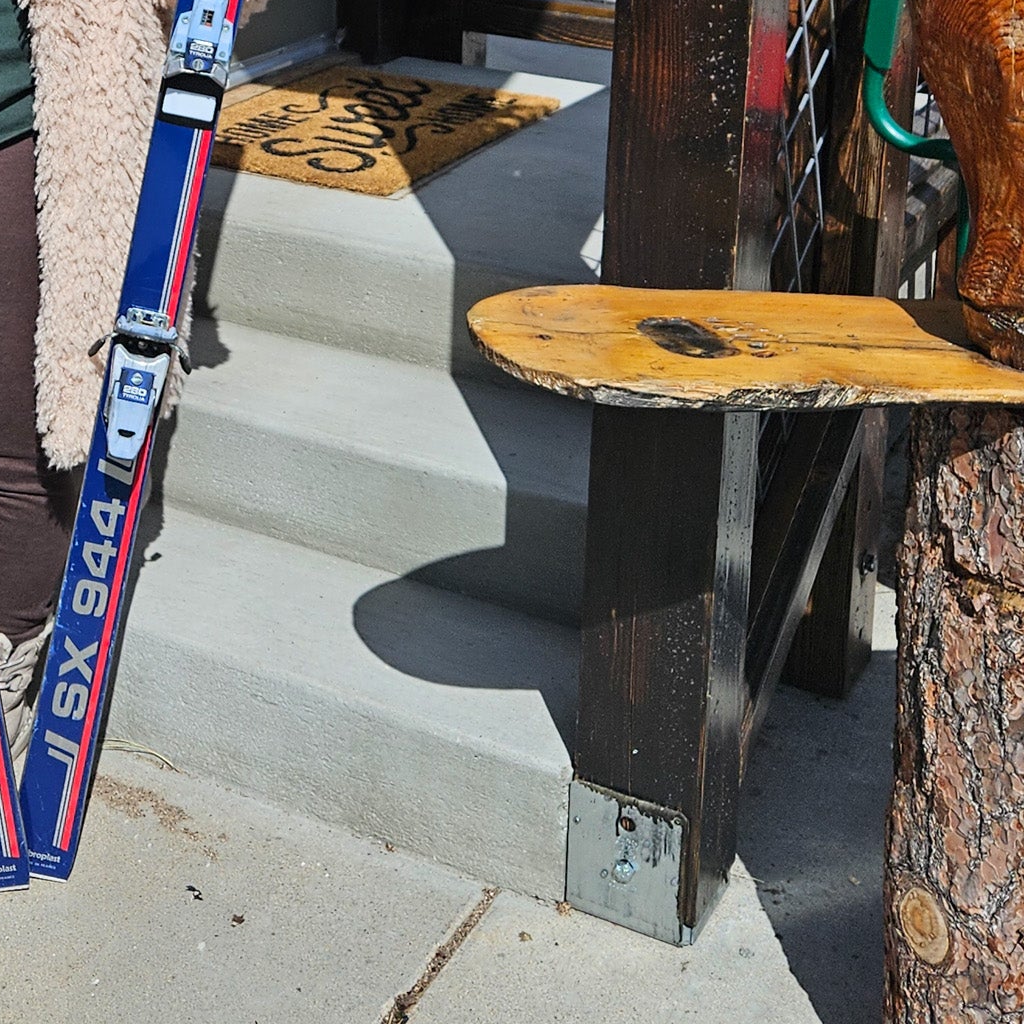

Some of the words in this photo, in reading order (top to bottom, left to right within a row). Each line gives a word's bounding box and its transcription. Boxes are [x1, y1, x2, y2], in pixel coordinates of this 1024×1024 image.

[260, 76, 432, 175] Sweet
[122, 384, 148, 397] 280
[72, 497, 127, 619] 944
[51, 634, 99, 721] SX
